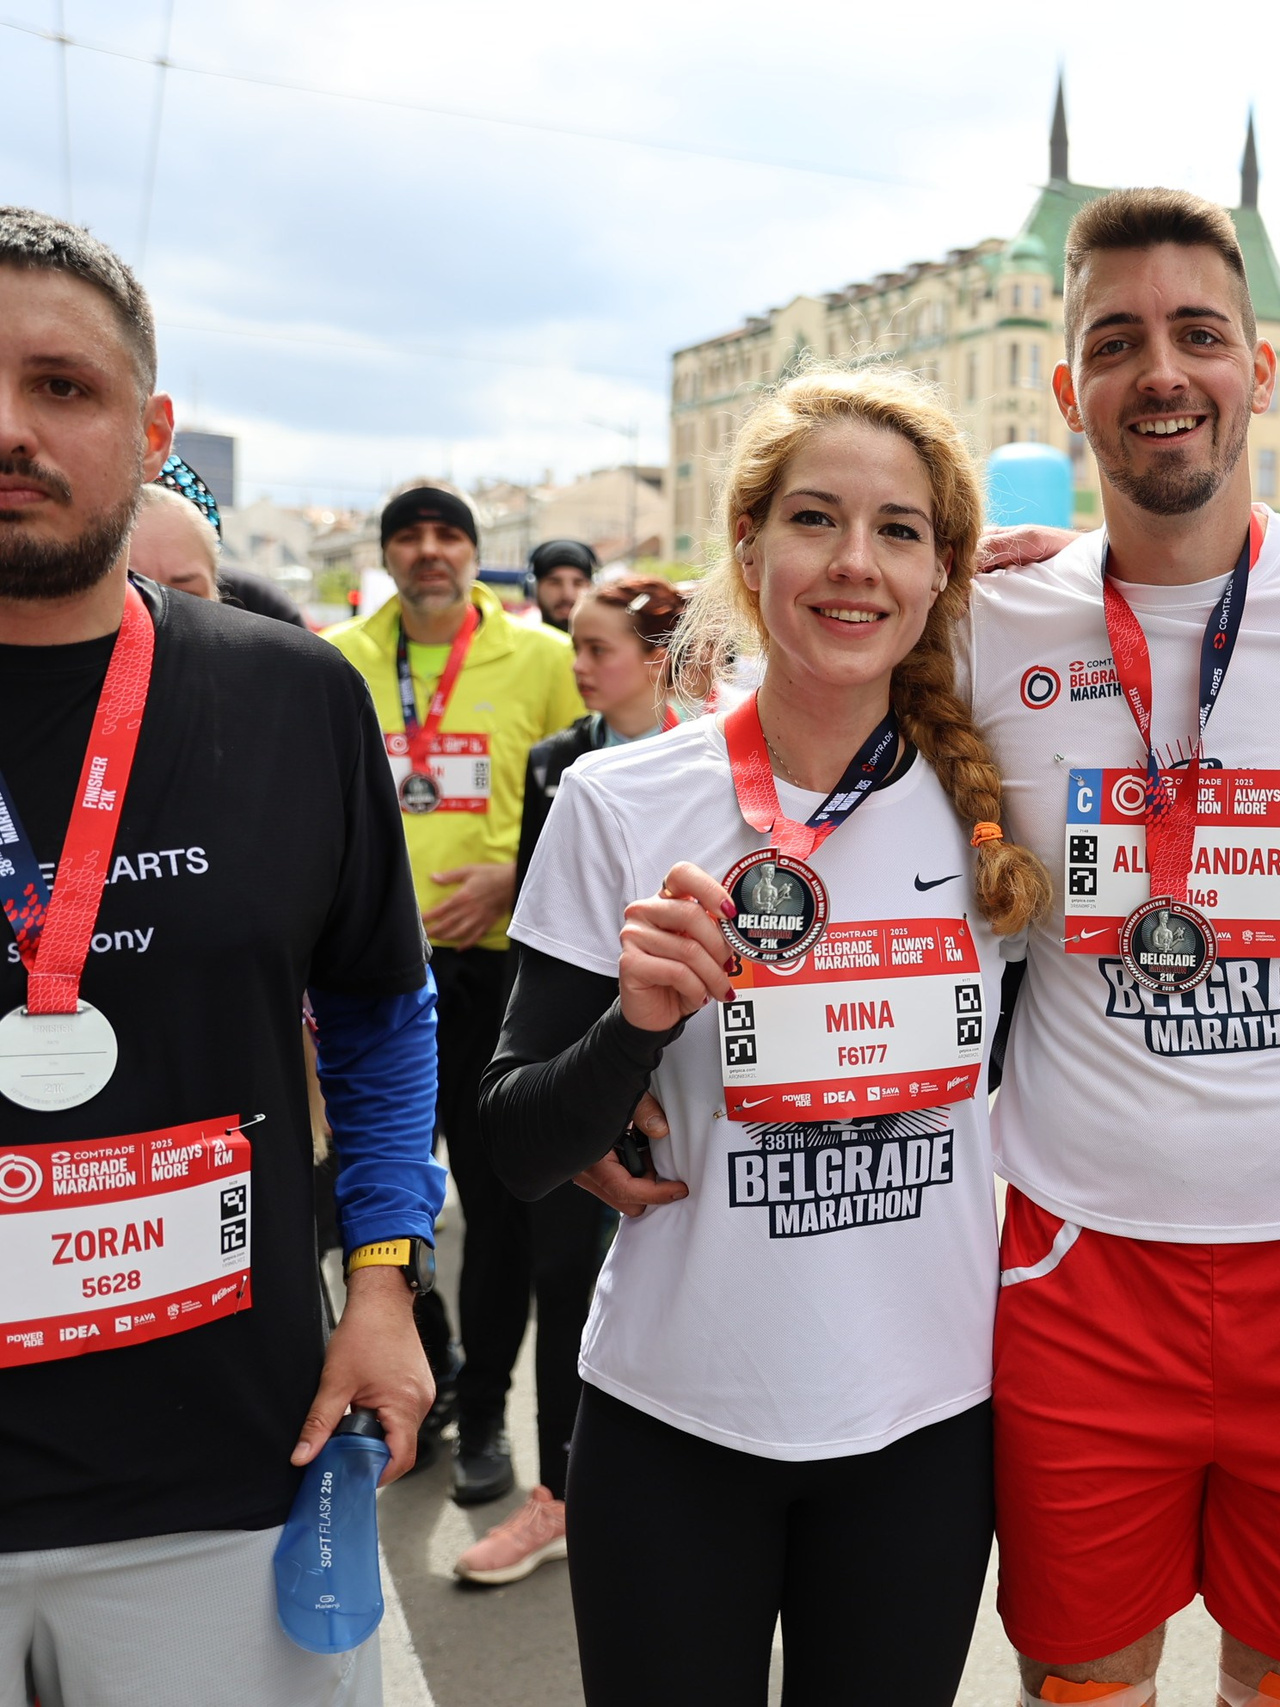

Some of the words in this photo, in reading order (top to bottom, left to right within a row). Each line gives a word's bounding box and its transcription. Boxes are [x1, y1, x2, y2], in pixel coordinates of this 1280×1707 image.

[1219, 578, 1234, 631] COMTRADE
[1086, 658, 1116, 669] COMT
[1070, 669, 1120, 688] BELGRA
[1210, 668, 1223, 696] 2025
[1070, 683, 1123, 702] MARATH
[868, 731, 894, 766] COMTRADE
[82, 756, 108, 809] FINISHER
[1175, 778, 1222, 786] CRADE
[1234, 778, 1254, 786] 2025
[98, 789, 117, 811] 21K
[1077, 787, 1093, 813] C
[1234, 789, 1280, 802] ALWAYS
[1234, 802, 1267, 815] MORE
[0, 792, 20, 844] MARA
[1187, 889, 1218, 908] 148
[738, 914, 804, 931] BELGRADE
[890, 927, 909, 936] 2025
[760, 938, 778, 949] 21K
[829, 929, 879, 940] COMTRADE
[944, 936, 955, 949] 21
[7, 927, 155, 964] sony
[813, 940, 873, 957] BELGRADE
[891, 937, 935, 951] ALWAYS
[814, 953, 880, 970] MARATHON
[891, 951, 923, 965] MORE
[946, 949, 963, 962] KM
[1140, 952, 1196, 967] BELGRADE
[1160, 973, 1175, 982] 21K
[825, 1000, 895, 1033] MINA
[837, 1044, 888, 1066] F6177
[782, 1093, 811, 1102] POWER
[881, 1087, 900, 1095] SAVA
[151, 1138, 173, 1149] 2025
[212, 1139, 226, 1152] 21
[765, 1132, 805, 1151] 38TH
[74, 1145, 135, 1160] COMTRADE
[151, 1144, 203, 1168] ALWAYS
[215, 1150, 233, 1167] KM
[52, 1158, 127, 1180] BELGRADE
[151, 1162, 189, 1182] MORE
[734, 1134, 951, 1203] BELGRADE
[53, 1172, 136, 1195] MARATHON
[775, 1188, 918, 1235] MARATHON
[51, 1217, 164, 1266] ZORAN
[82, 1270, 141, 1299] 5628
[134, 1312, 156, 1324] SAVA
[7, 1331, 44, 1344] POWER
[320, 1471, 334, 1494] 250
[319, 1496, 331, 1534] FLASK
[319, 1537, 332, 1568] SOFT
